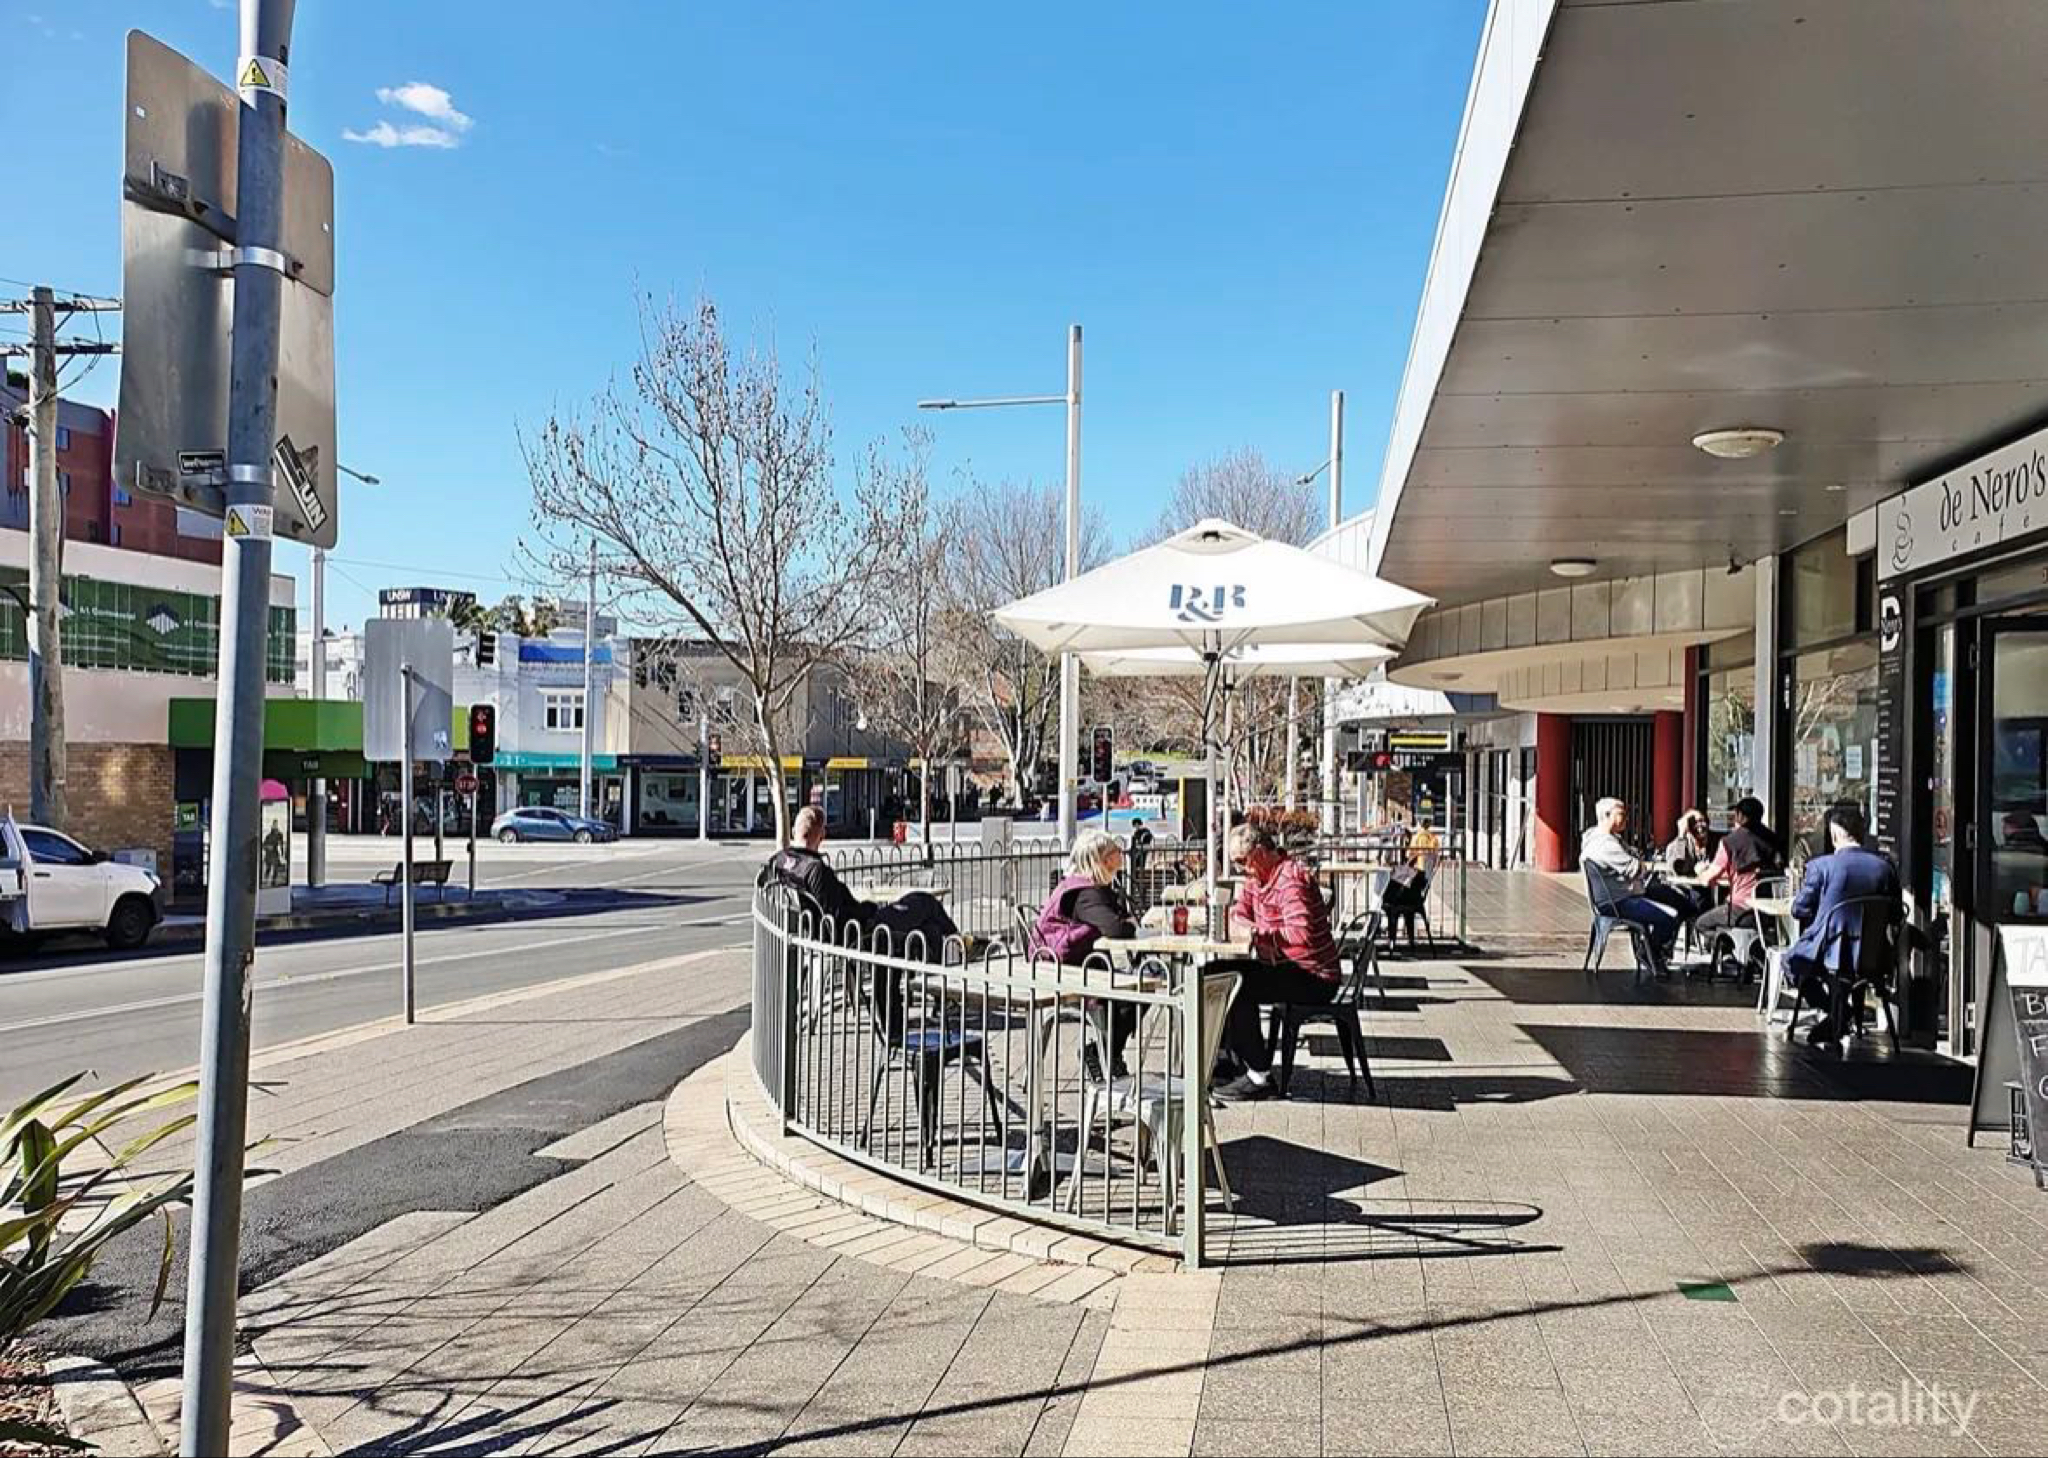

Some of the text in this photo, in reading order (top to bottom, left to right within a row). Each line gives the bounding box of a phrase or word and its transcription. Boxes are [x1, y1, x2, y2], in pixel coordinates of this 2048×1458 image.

[1939, 449, 2046, 532] de Nero's
[182, 812, 195, 821] TAB
